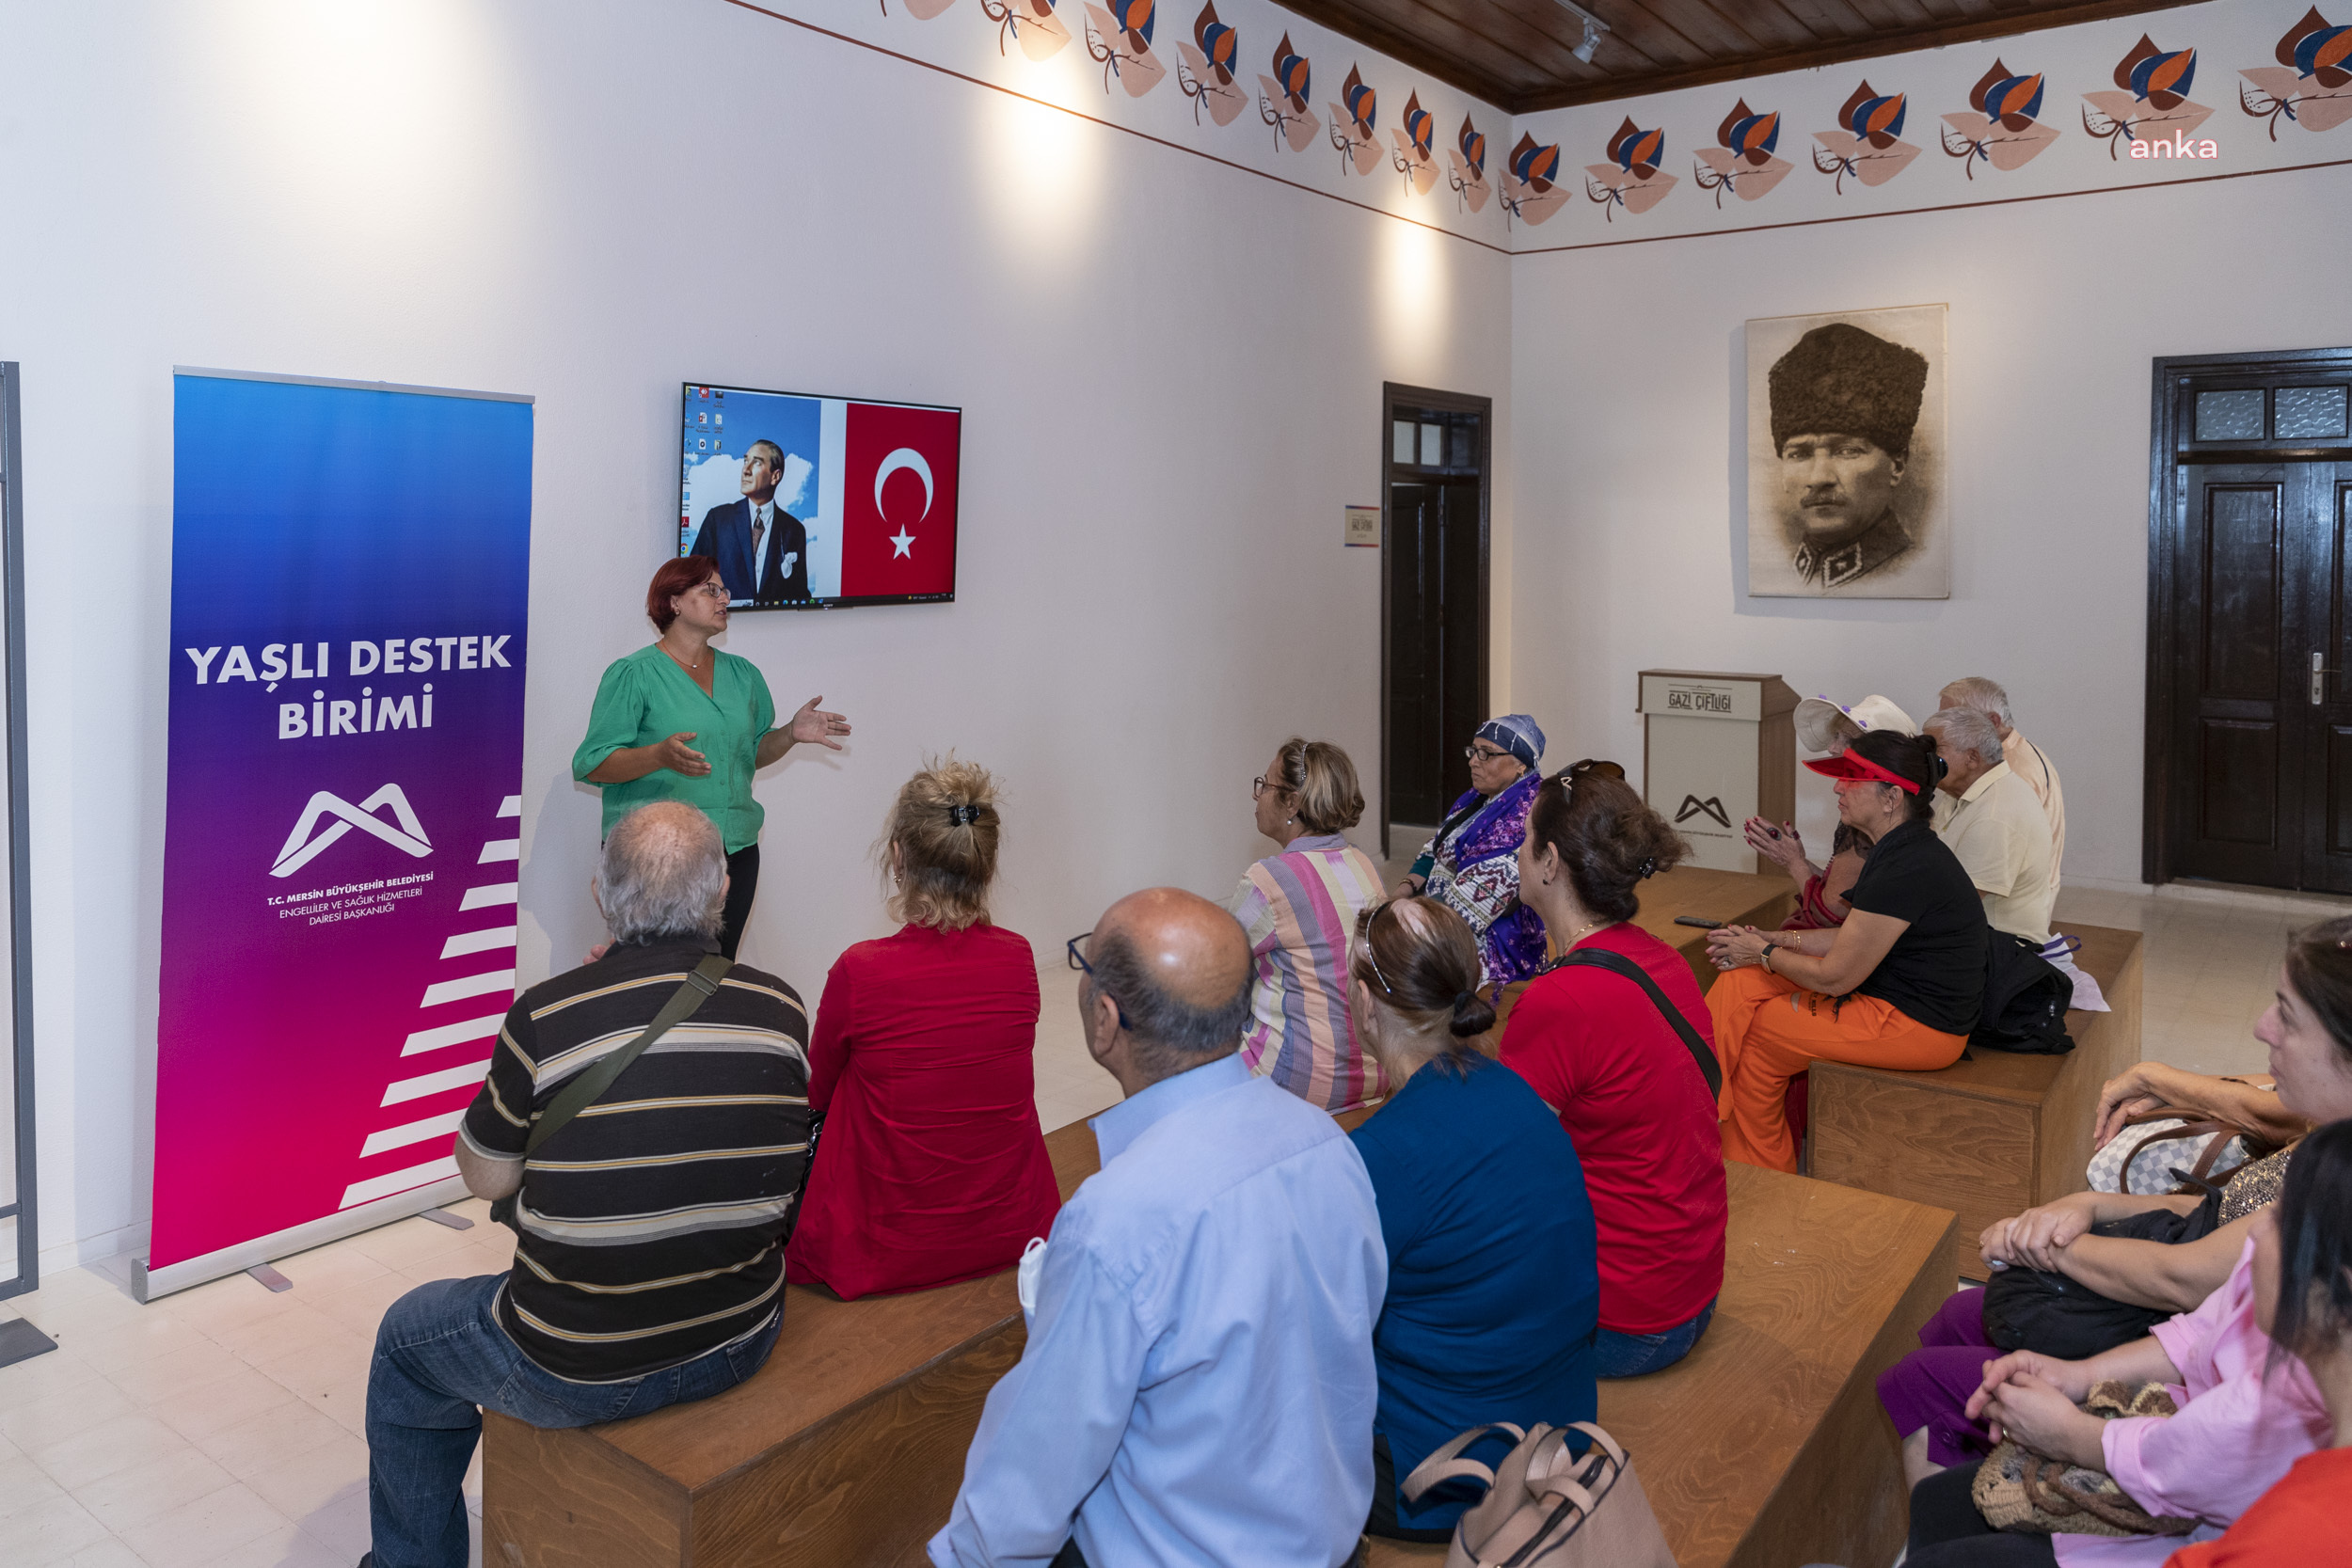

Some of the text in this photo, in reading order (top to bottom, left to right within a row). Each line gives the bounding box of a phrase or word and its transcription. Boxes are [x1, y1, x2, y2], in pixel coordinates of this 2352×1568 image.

[184, 634, 512, 693] YAŞLI DESTEK
[278, 682, 434, 740] BİRİMİ
[267, 871, 434, 906] T.C. MERSİN BÜYÜKŞEHİR BELEDİYESİ
[279, 886, 423, 919] ENGELLİLER VE SAĞLIK HİZMETLERİ
[309, 902, 395, 926] DAİRESİ BAŞKANLIĞI
